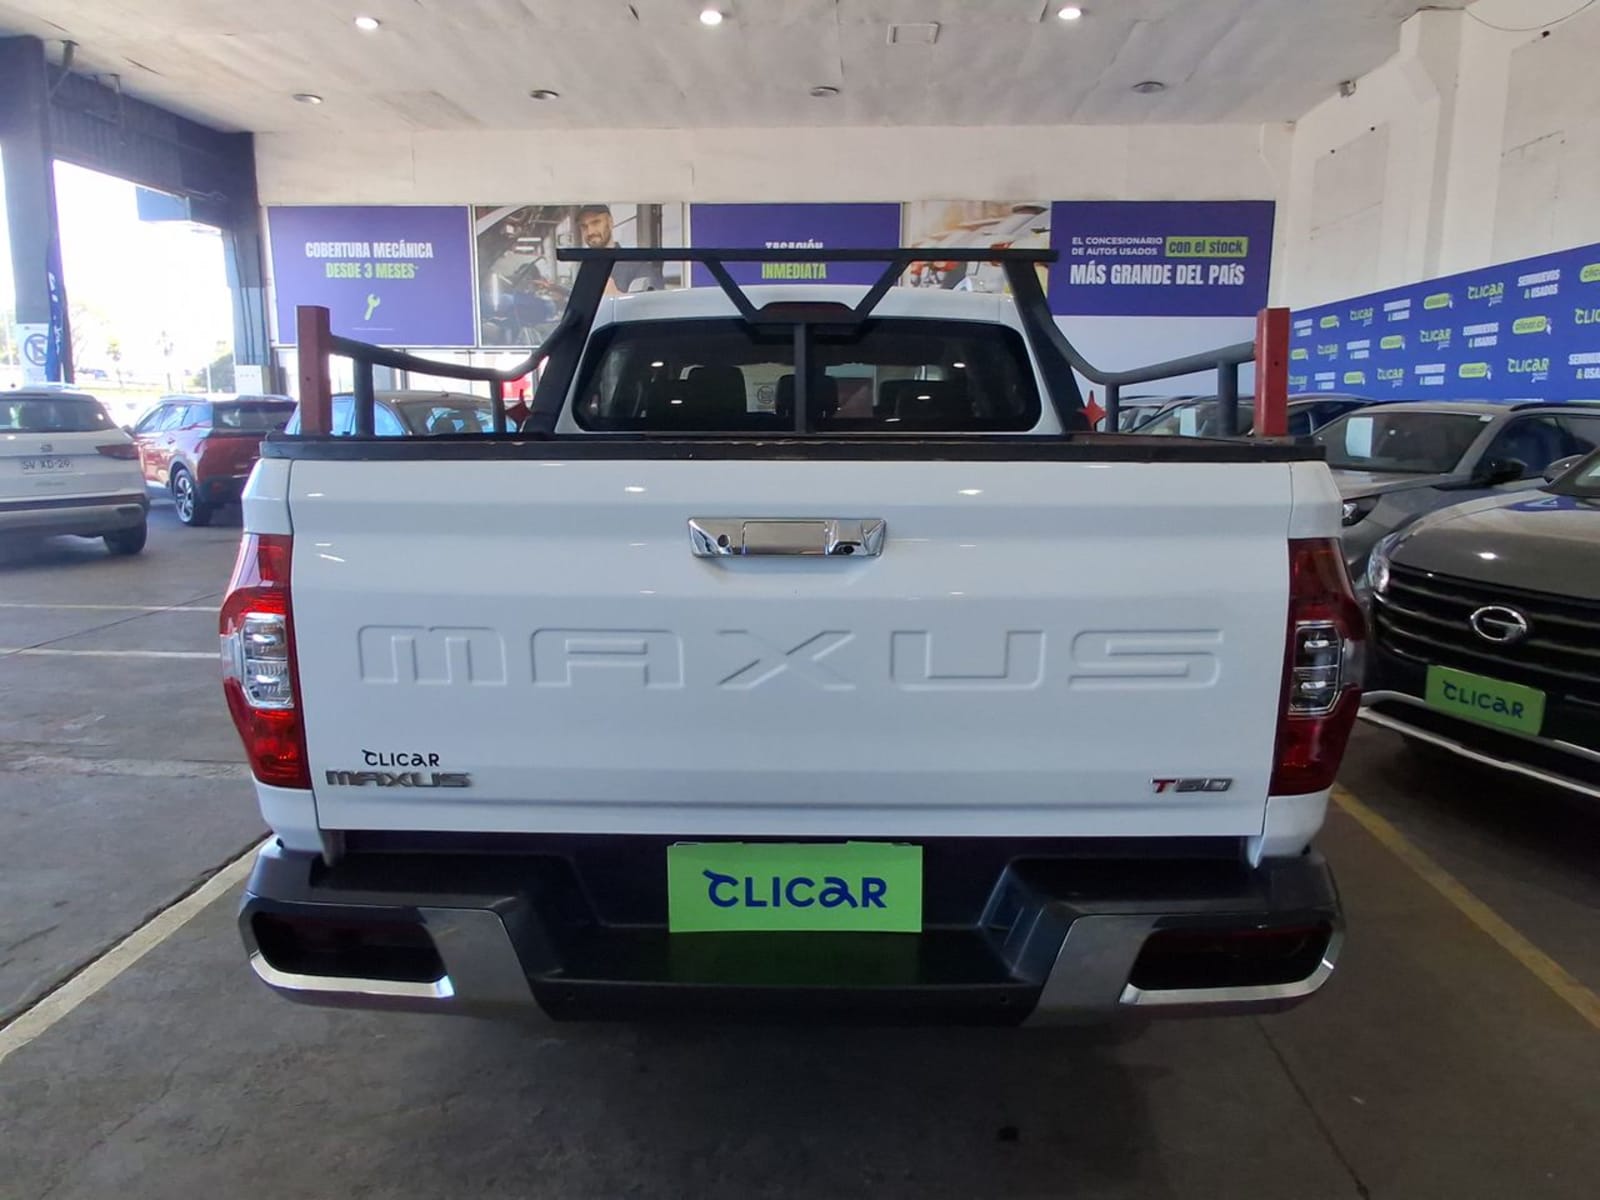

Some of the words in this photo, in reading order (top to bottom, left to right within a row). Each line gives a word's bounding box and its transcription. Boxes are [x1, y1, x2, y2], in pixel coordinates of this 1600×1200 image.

[305, 242, 371, 258] COBERTURA
[374, 239, 434, 258] MECÁNICA
[1072, 237, 1083, 245] EL
[1086, 237, 1163, 245] CONCESIONARIO
[1169, 242, 1191, 254] con
[1195, 241, 1205, 254] el
[1209, 240, 1244, 254] stock
[325, 263, 361, 278] DESDE
[364, 263, 372, 278] 3
[761, 263, 827, 279] INMEDIATA
[1070, 261, 1106, 284] MÁS
[1111, 265, 1171, 284] GRANDE
[1176, 265, 1203, 284] DEL
[1208, 263, 1245, 284] PAÍS
[1575, 309, 1600, 324] CLIC
[357, 625, 1225, 692] MAXUS
[326, 770, 471, 788] MAXUS
